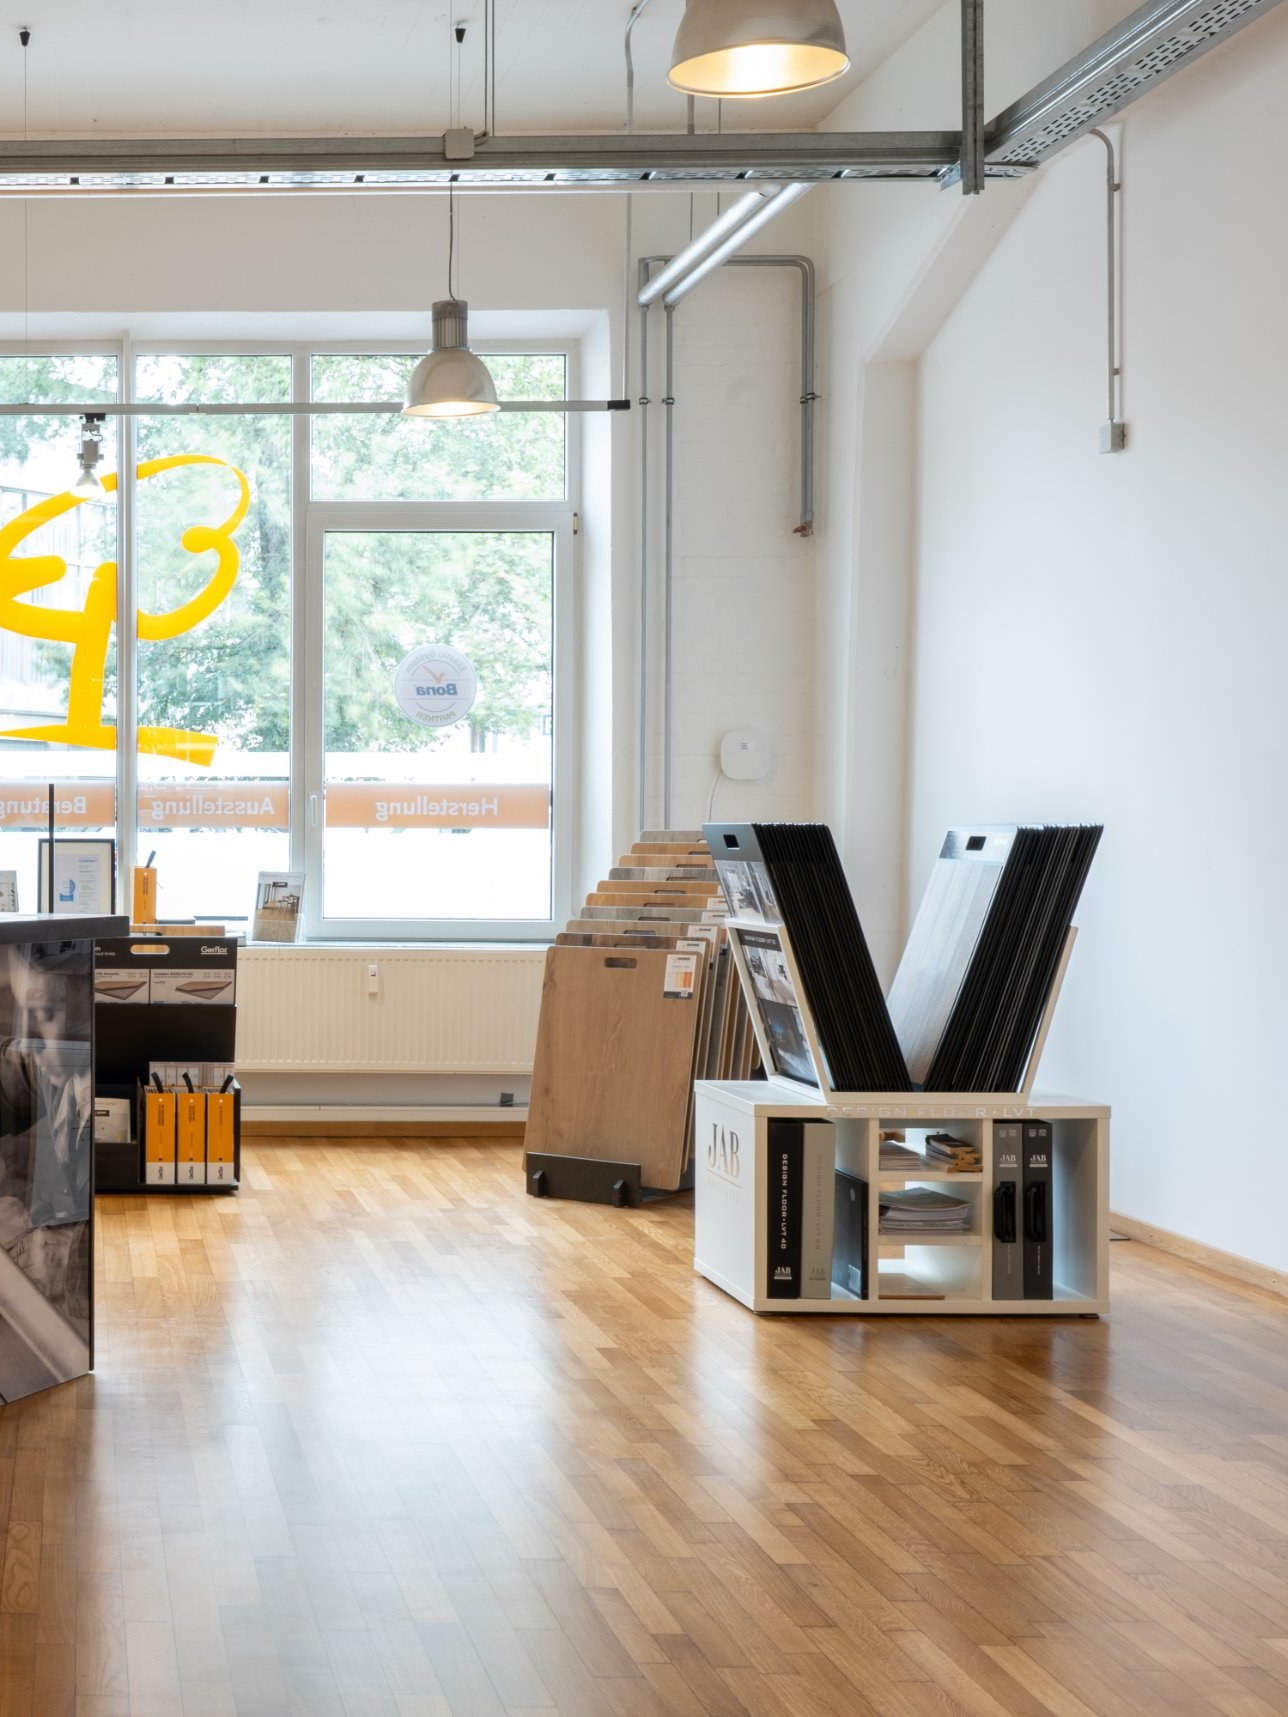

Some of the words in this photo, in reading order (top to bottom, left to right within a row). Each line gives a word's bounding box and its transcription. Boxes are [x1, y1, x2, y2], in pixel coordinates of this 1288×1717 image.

[200, 945, 228, 956] Gerflor
[826, 1106, 906, 1117] DESIGN
[1003, 1107, 1037, 1118] LVT
[708, 1123, 740, 1178] JAB
[775, 1266, 791, 1274] JAB
